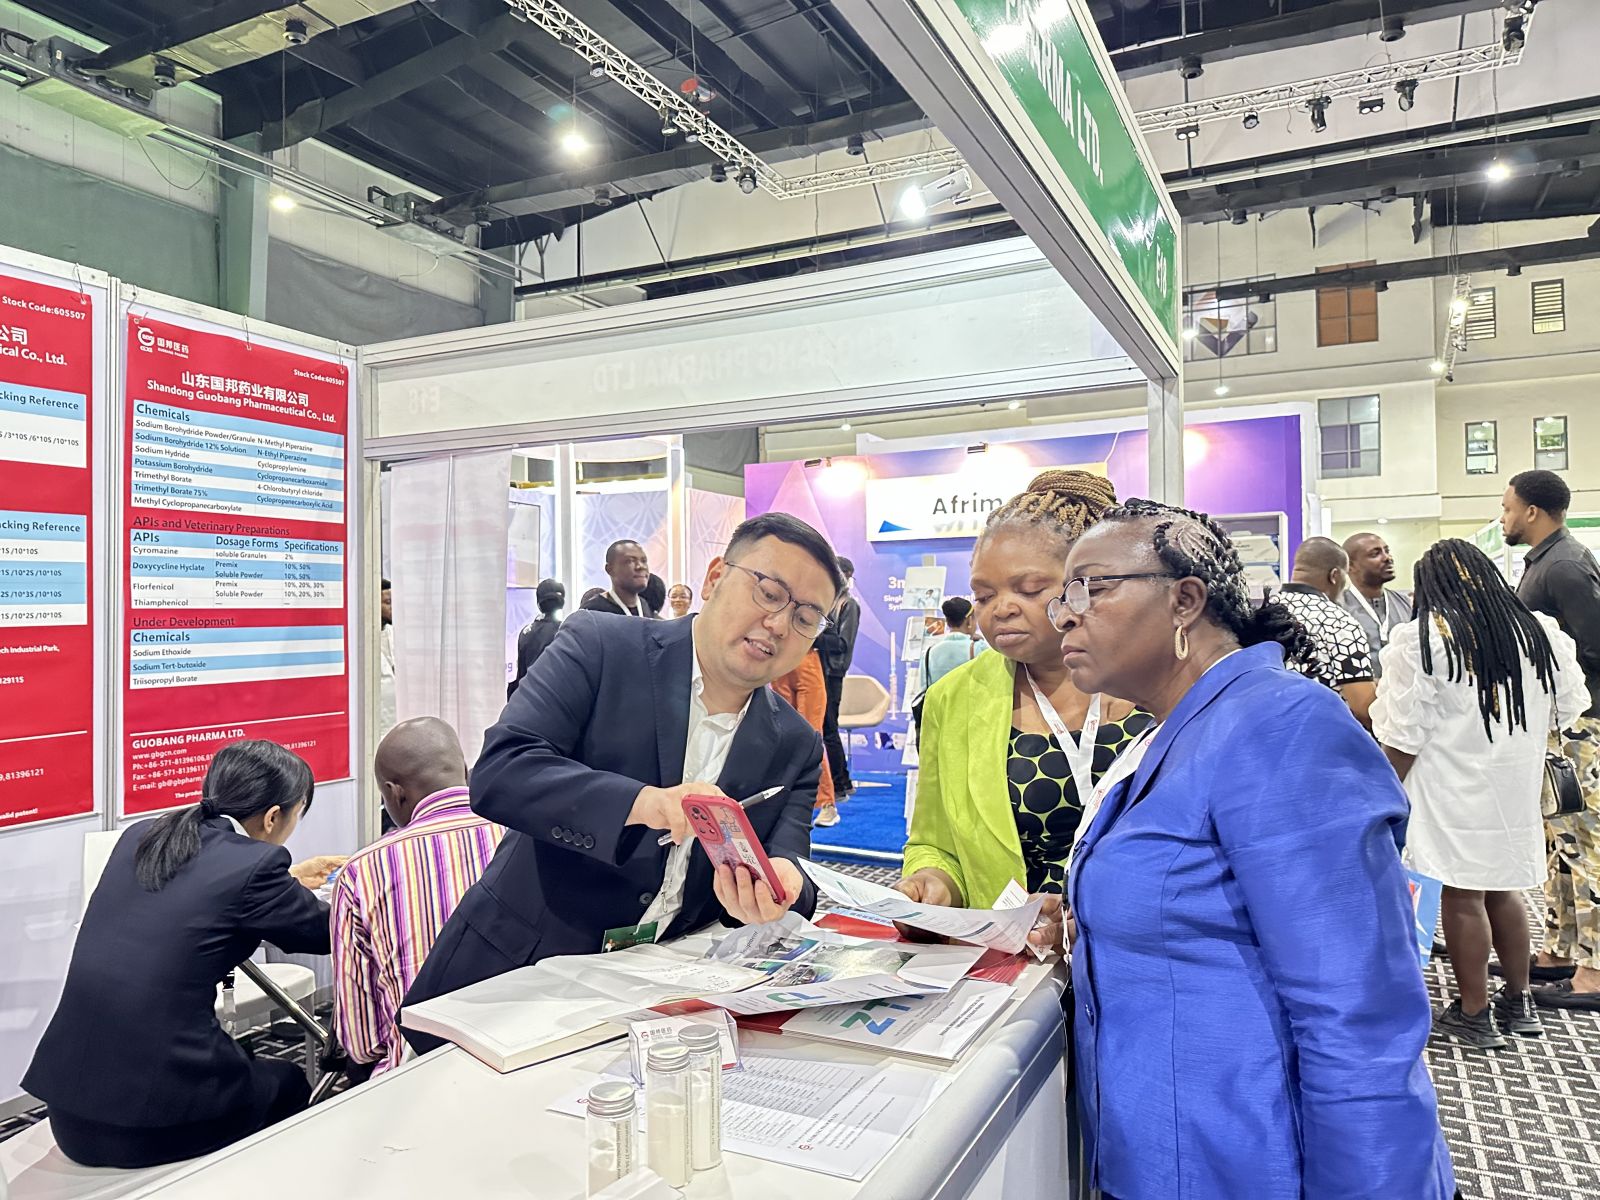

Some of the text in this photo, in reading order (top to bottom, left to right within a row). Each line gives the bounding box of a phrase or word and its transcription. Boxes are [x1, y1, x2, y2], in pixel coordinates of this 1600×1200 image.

[1077, 89, 1104, 188] LTD.
[2, 295, 86, 320] Stock Code:605507
[21, 348, 43, 363] Co.,
[46, 352, 67, 366] Ltd.
[294, 369, 309, 379] Stock
[181, 371, 309, 407] 山东国邦药业有限公司
[29, 394, 79, 410] Reference
[147, 380, 336, 423] Shandong Guobang Pharmaceutical Co., Ltd.
[136, 403, 190, 422] Chemicals
[136, 419, 256, 443] Sodium Borohydride Powder/Granule
[135, 432, 247, 454] Sodium Borohydride 12% Solution
[257, 438, 313, 452] N-Methyl Piperazine
[135, 445, 190, 459] Sodium Hydride
[257, 449, 307, 462] N-Ethyl Piperazine
[134, 458, 213, 474] Potassium Borohydride
[257, 460, 306, 473] Cyclopropylamine
[134, 471, 192, 483] Trimethyl Borate
[134, 483, 208, 497] Trimethyl Borate 75%
[134, 496, 160, 506] Methyl
[32, 521, 80, 532] Reference
[133, 516, 290, 535] APIs and Veterinary Preparations
[133, 532, 160, 542] APIs
[216, 536, 278, 549] Dosage Forms
[133, 546, 179, 555] Cyromazine
[284, 541, 339, 553] Specifications
[215, 551, 267, 560] soluble Granules
[132, 562, 205, 572] Doxycycline Hyclate
[133, 583, 174, 591] Florfenicol
[134, 599, 189, 607] Thiamphenicol
[133, 617, 235, 628] Under Development
[133, 631, 190, 642] Chemicals
[10, 645, 42, 653] Industrial
[43, 644, 60, 652] Park,
[133, 648, 191, 657] Sodium Ethoxide
[133, 661, 207, 671] Sodium Tert-butoxide
[132, 729, 246, 750] GUOBANG PHARMA LTD.
[132, 748, 187, 760] www.gbgcn.com
[132, 773, 147, 781] Fax:
[132, 781, 157, 791] E-mail:
